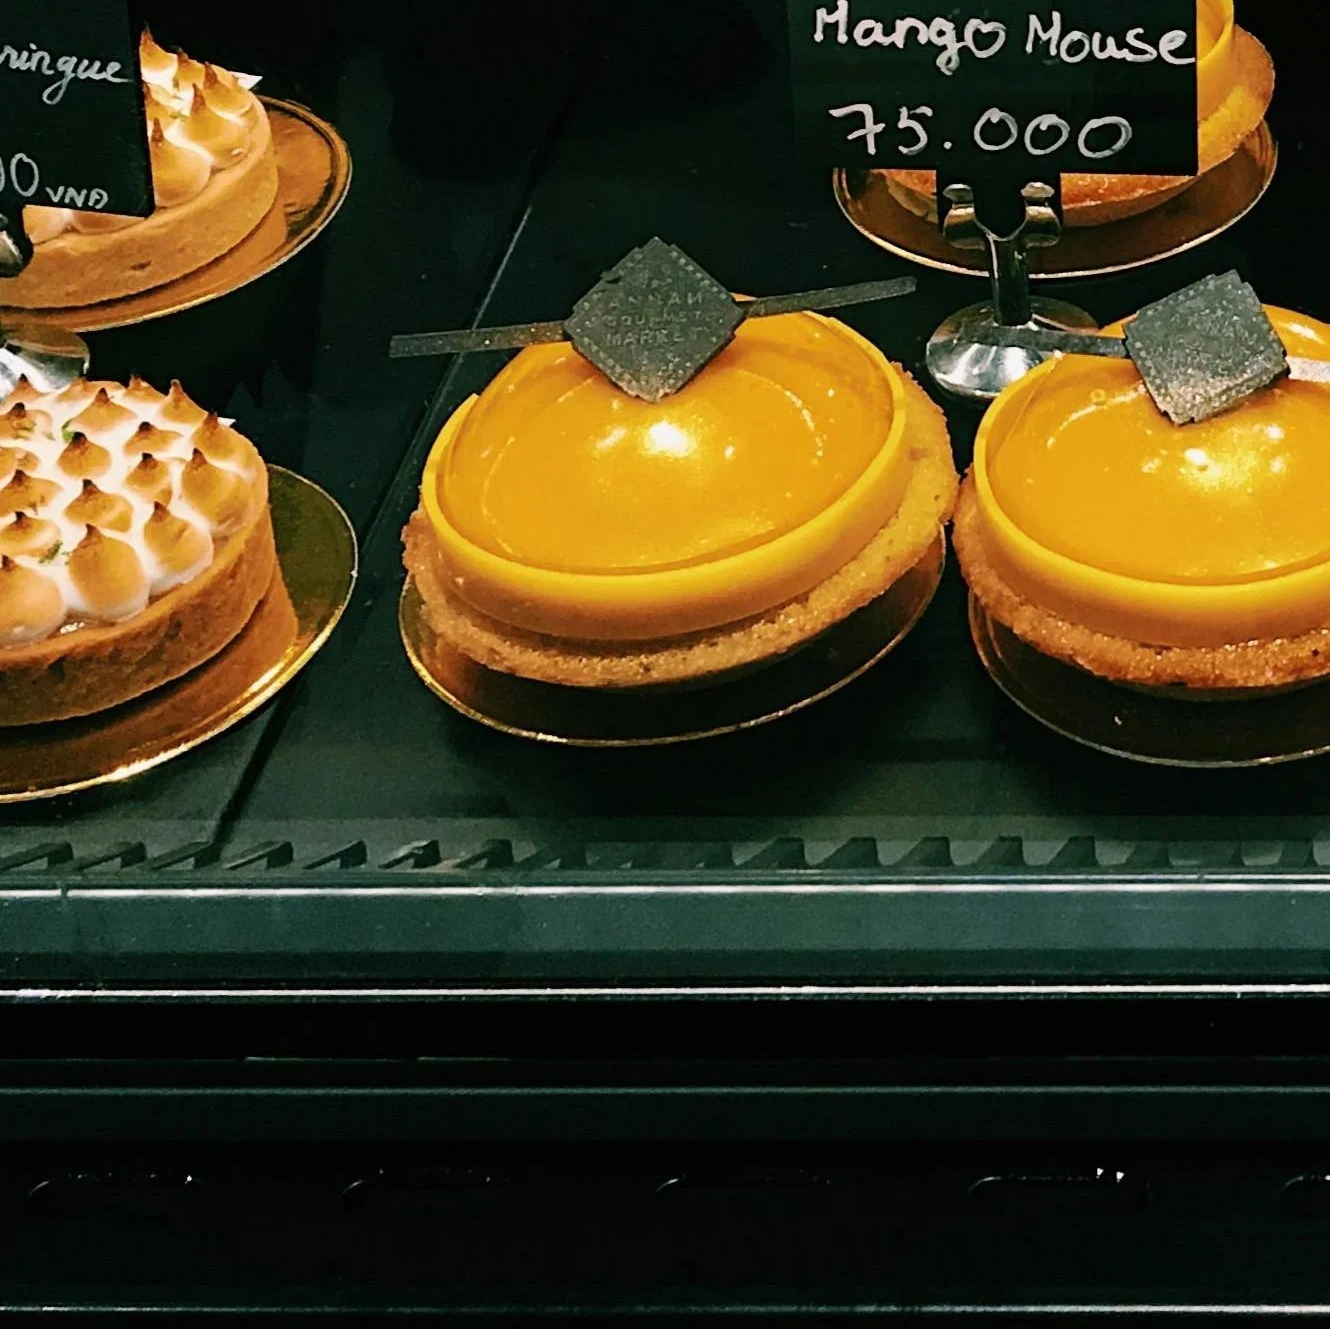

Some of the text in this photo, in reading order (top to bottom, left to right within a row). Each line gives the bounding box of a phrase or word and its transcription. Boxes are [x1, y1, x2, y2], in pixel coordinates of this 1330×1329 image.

[814, 0, 1195, 75] Mango Mouse
[829, 104, 1131, 158] 75.000
